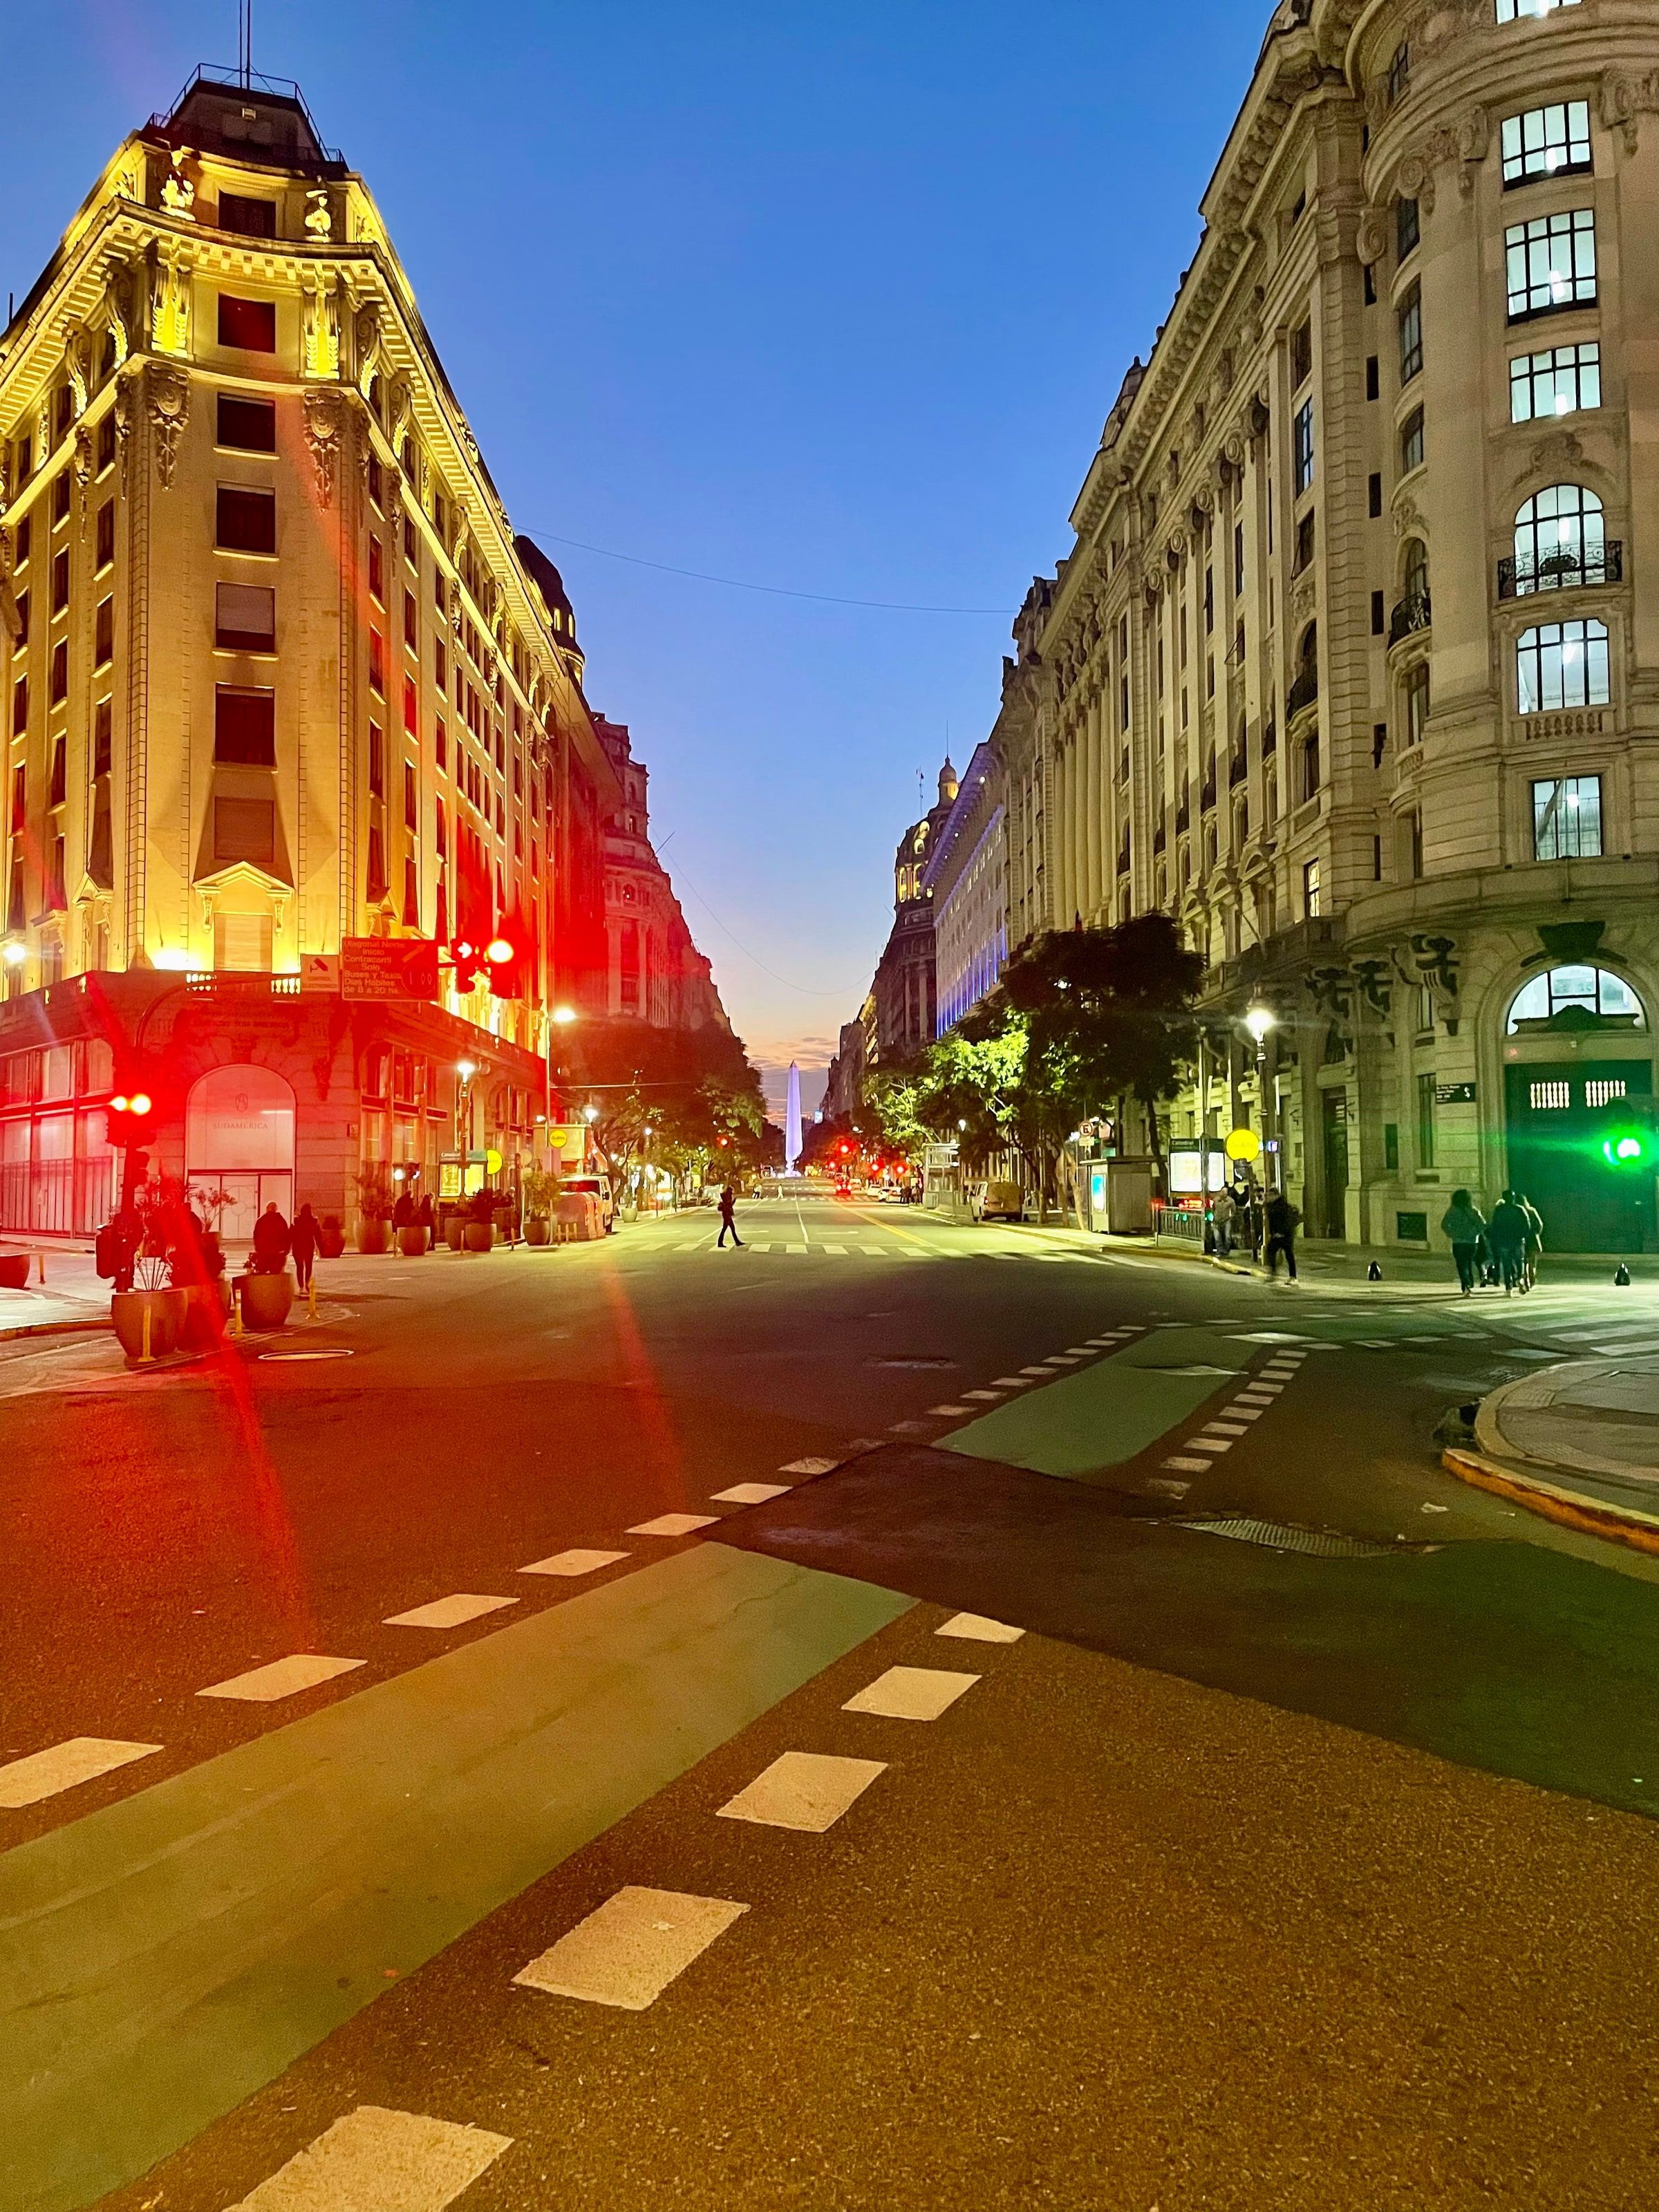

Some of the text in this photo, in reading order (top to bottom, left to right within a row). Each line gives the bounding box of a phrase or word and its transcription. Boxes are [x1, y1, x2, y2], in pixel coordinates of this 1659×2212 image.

[344, 940, 379, 949] Diagonal
[344, 955, 392, 964] Contracarril
[344, 970, 370, 978] Buses
[373, 972, 378, 980] y
